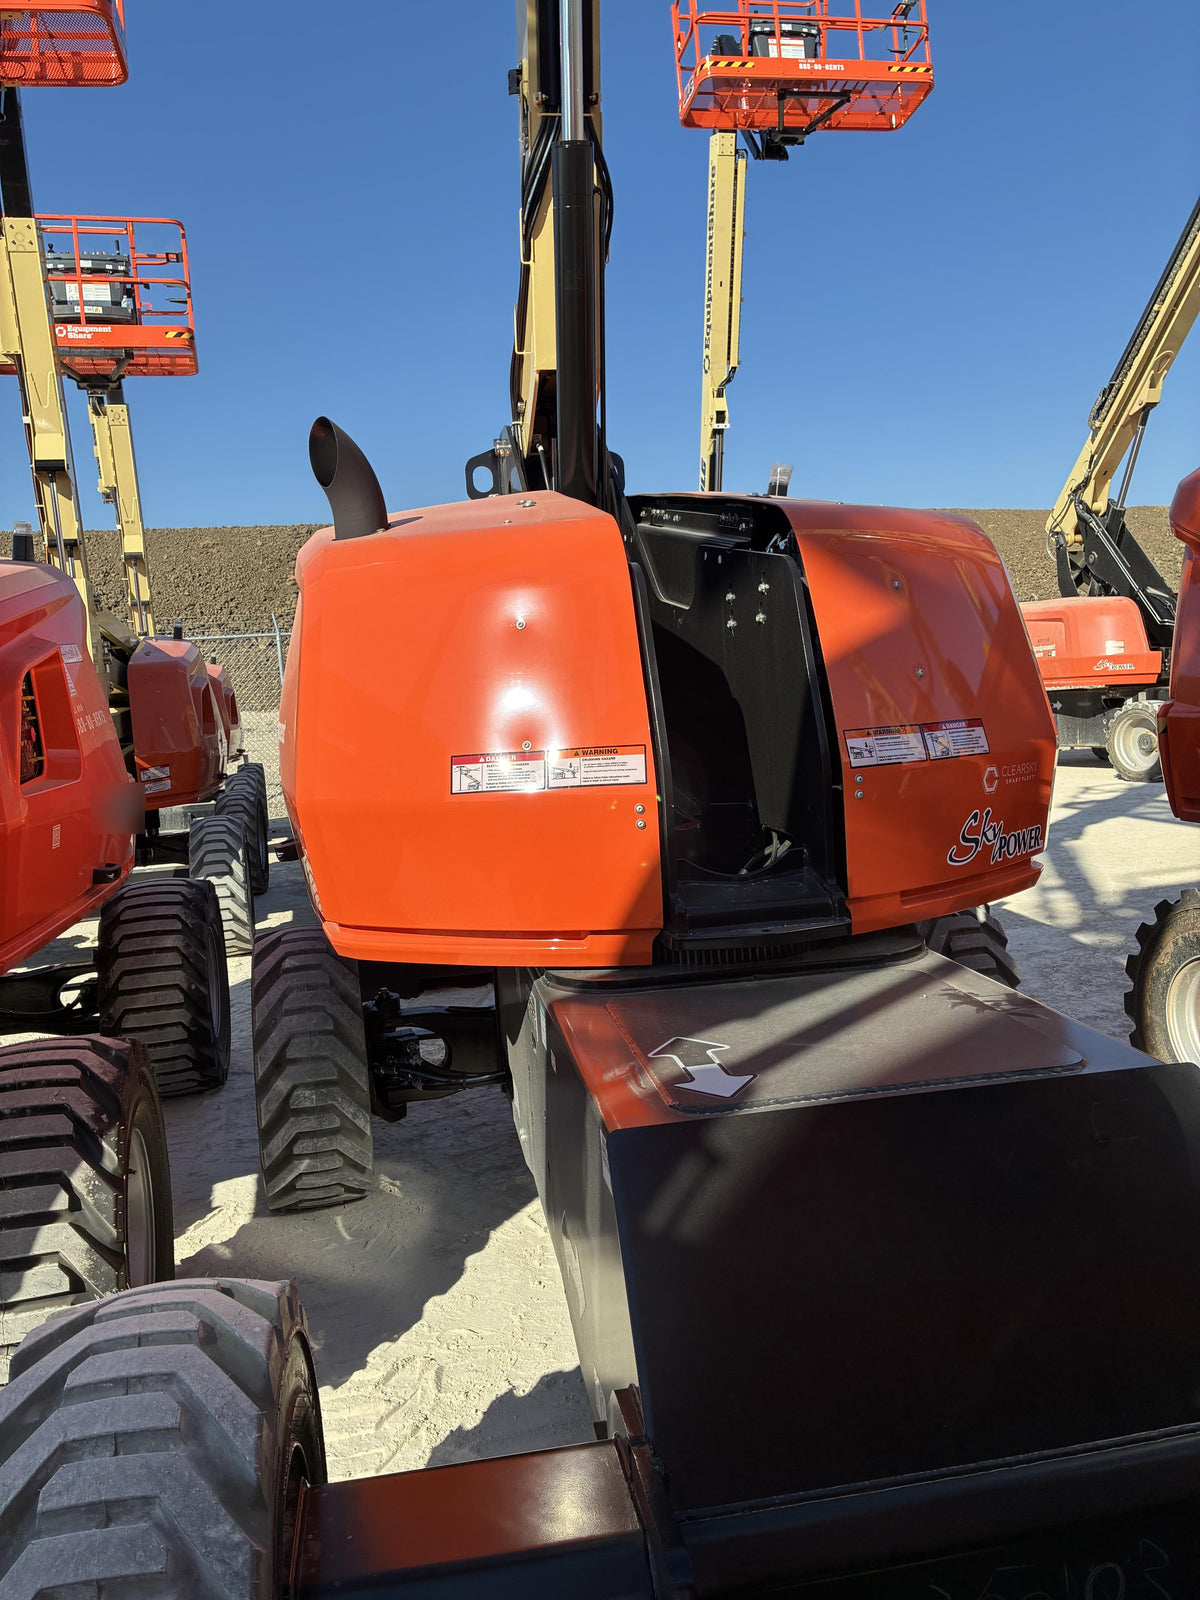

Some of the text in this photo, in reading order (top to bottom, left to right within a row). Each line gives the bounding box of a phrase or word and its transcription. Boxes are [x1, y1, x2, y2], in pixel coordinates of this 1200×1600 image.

[67, 325, 112, 333] Equipment
[946, 721, 967, 729] DANGER
[582, 748, 618, 756] WARNING
